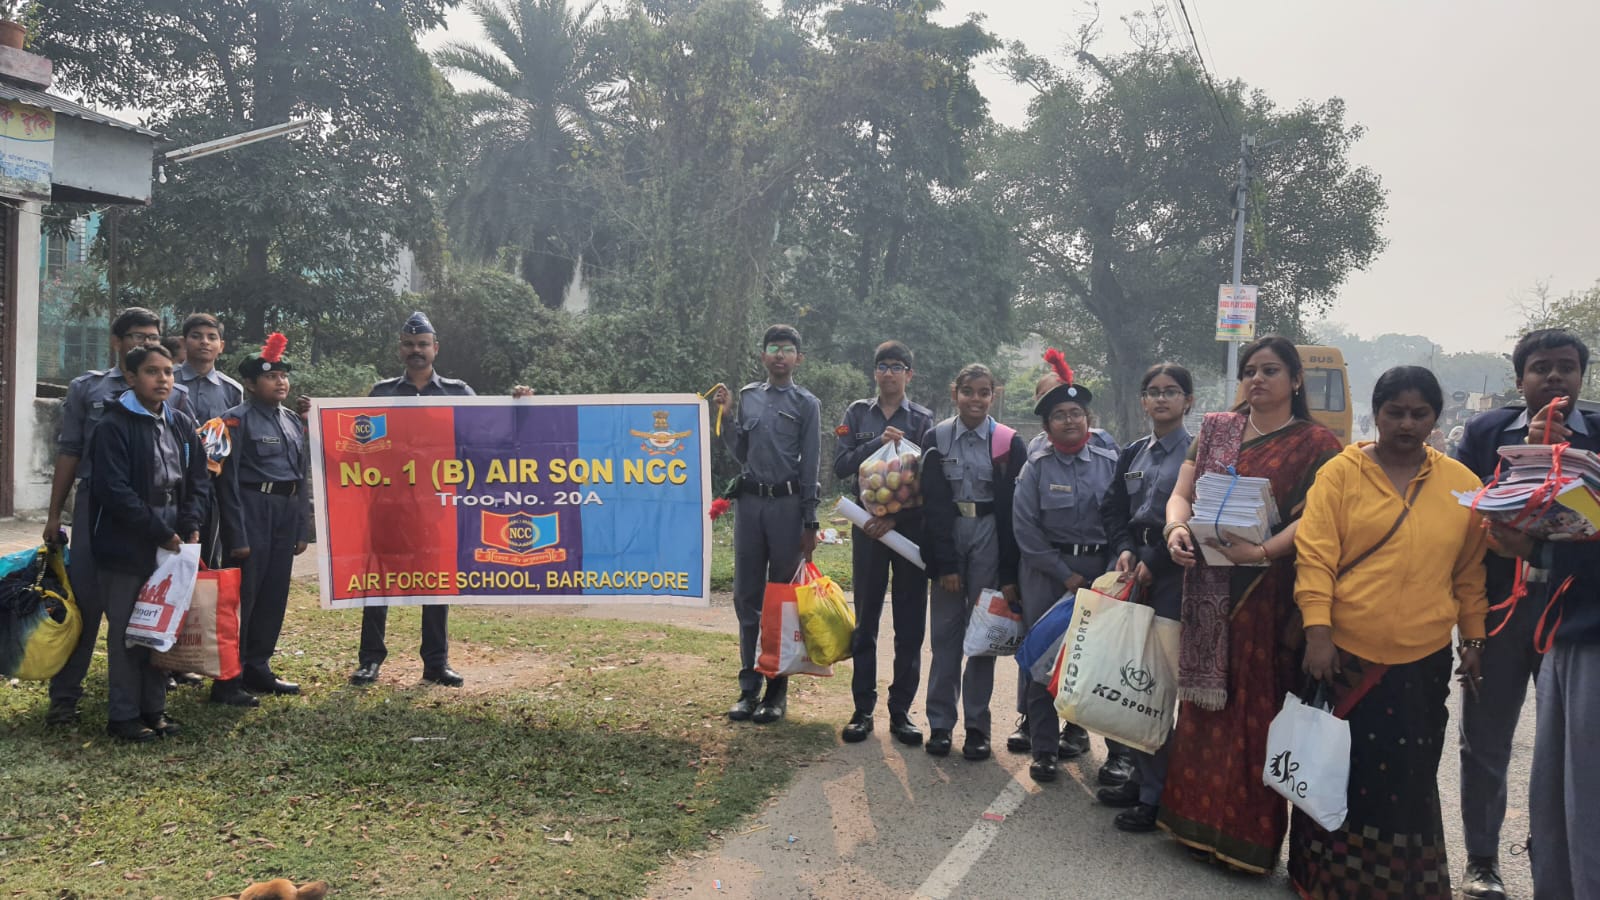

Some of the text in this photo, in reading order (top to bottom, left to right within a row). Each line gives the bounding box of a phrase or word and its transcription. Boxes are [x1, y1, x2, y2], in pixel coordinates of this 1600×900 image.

[1310, 356, 1334, 364] BUS
[355, 424, 370, 434] NCC
[340, 461, 391, 486] No.
[402, 459, 416, 485] 1
[432, 459, 475, 490] (B)
[485, 459, 540, 483] AIR
[624, 458, 687, 484] NCC
[505, 491, 545, 506] No.
[554, 491, 603, 505] 20A
[509, 527, 533, 539] NCC
[347, 570, 689, 591] AIR FORCE SCHOOL, BARRACKPORE
[1072, 608, 1092, 661] SPORTS
[1092, 683, 1122, 702] KD
